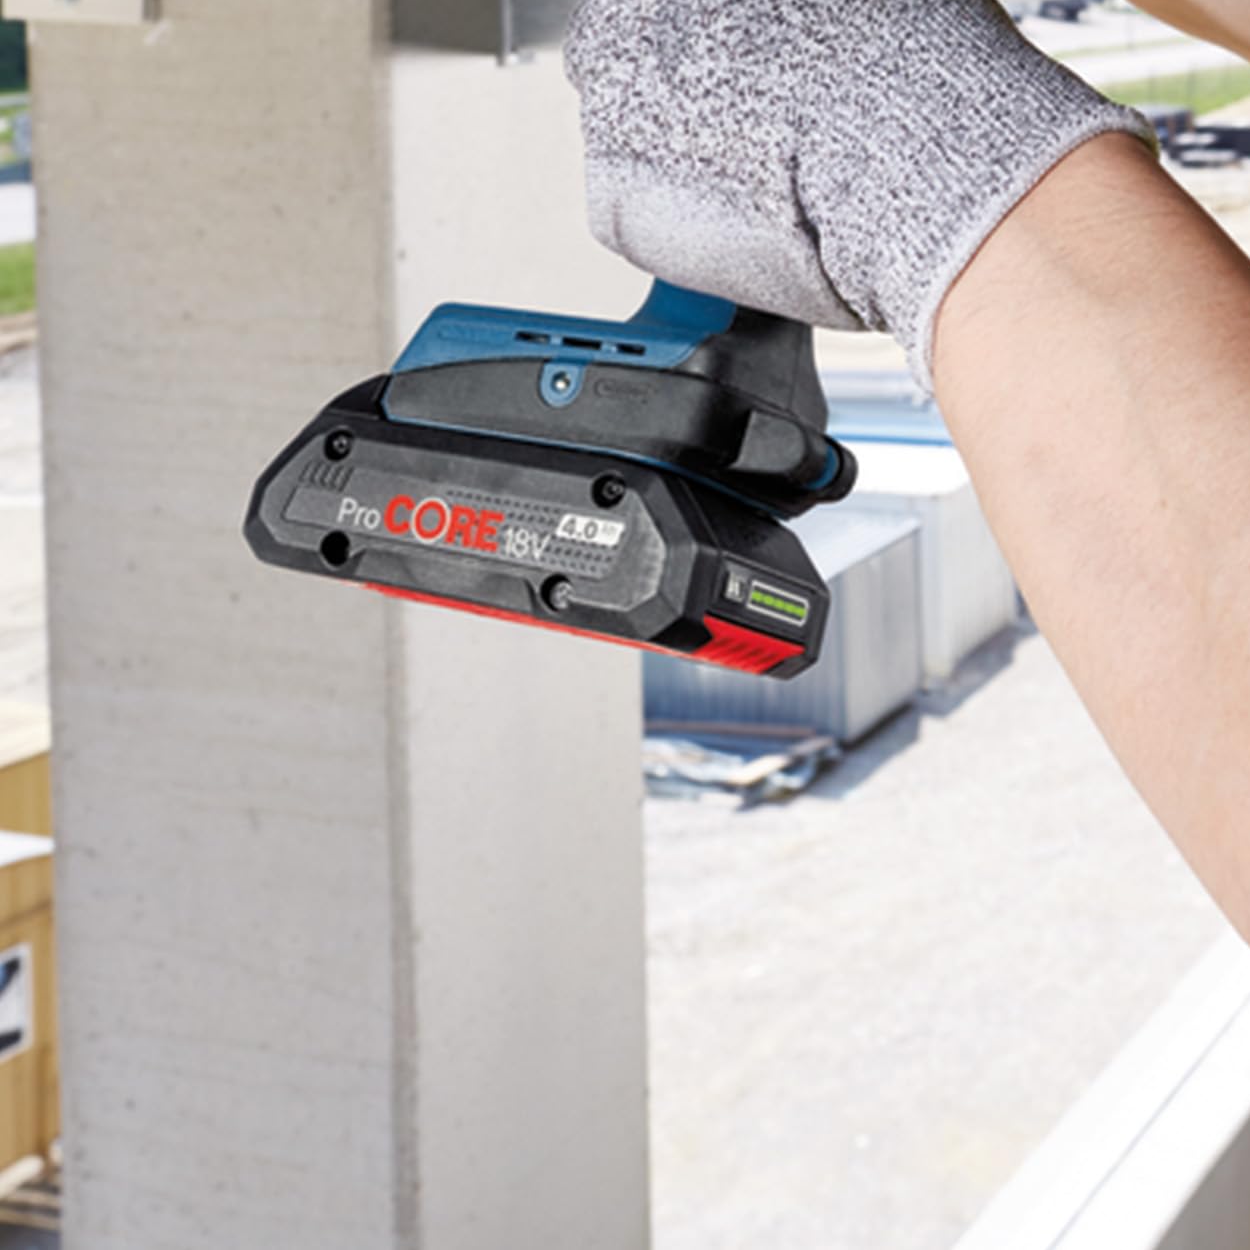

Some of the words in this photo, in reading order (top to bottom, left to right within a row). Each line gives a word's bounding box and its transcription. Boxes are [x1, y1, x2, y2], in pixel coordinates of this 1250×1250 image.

[336, 497, 382, 531] Pro
[384, 495, 505, 553] CORE
[503, 526, 550, 560] 18V
[561, 516, 600, 541] 4.0
